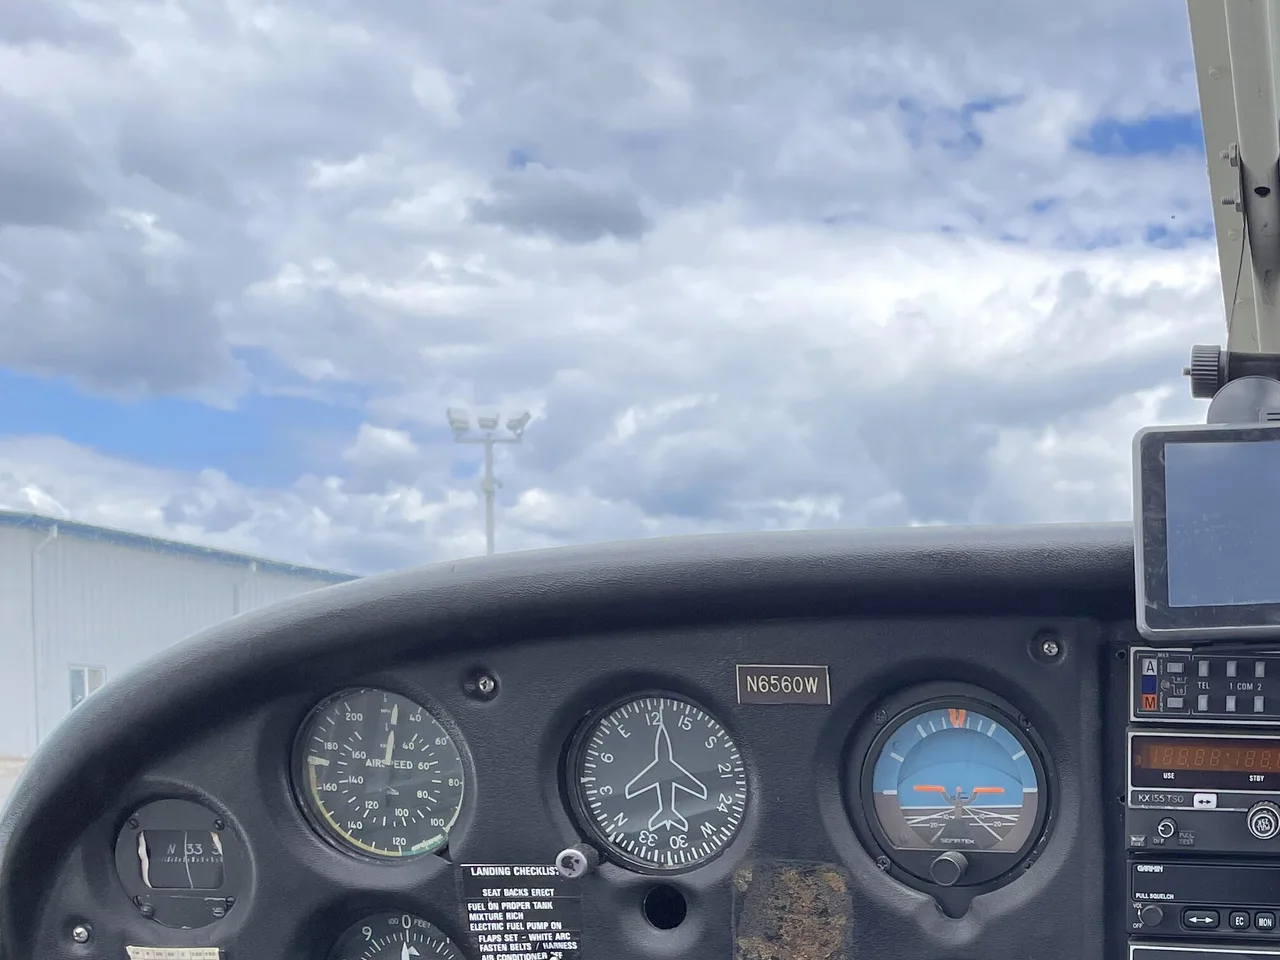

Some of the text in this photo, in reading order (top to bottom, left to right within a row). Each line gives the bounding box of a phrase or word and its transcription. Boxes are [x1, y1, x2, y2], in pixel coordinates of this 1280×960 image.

[746, 675, 819, 694] N6560W
[1197, 681, 1210, 690] TEL
[1237, 682, 1253, 691] COM
[345, 713, 363, 721] 200
[645, 712, 660, 726] 12
[678, 715, 693, 730] 15
[324, 742, 338, 750] 180
[365, 759, 413, 770] AIRSEED
[718, 763, 733, 778] 21
[323, 783, 337, 791] 160
[716, 793, 732, 813] 24
[1167, 795, 1184, 803] TSO
[639, 831, 658, 847] 33
[670, 835, 688, 848] 30
[470, 867, 510, 876] LANDING
[482, 888, 554, 897] SEAT BACKS ERECT
[467, 901, 553, 911] FUEL ON PROPER TANK
[468, 912, 524, 921] MIXTURE RICH
[1235, 916, 1244, 925] EC
[470, 922, 562, 931] ELECTRIC FUEL PUMP ON
[1258, 918, 1272, 927] MON
[478, 932, 571, 943] FLAPS SET WHITE ARC
[479, 942, 577, 952] FASTEN BELTS HARNESS
